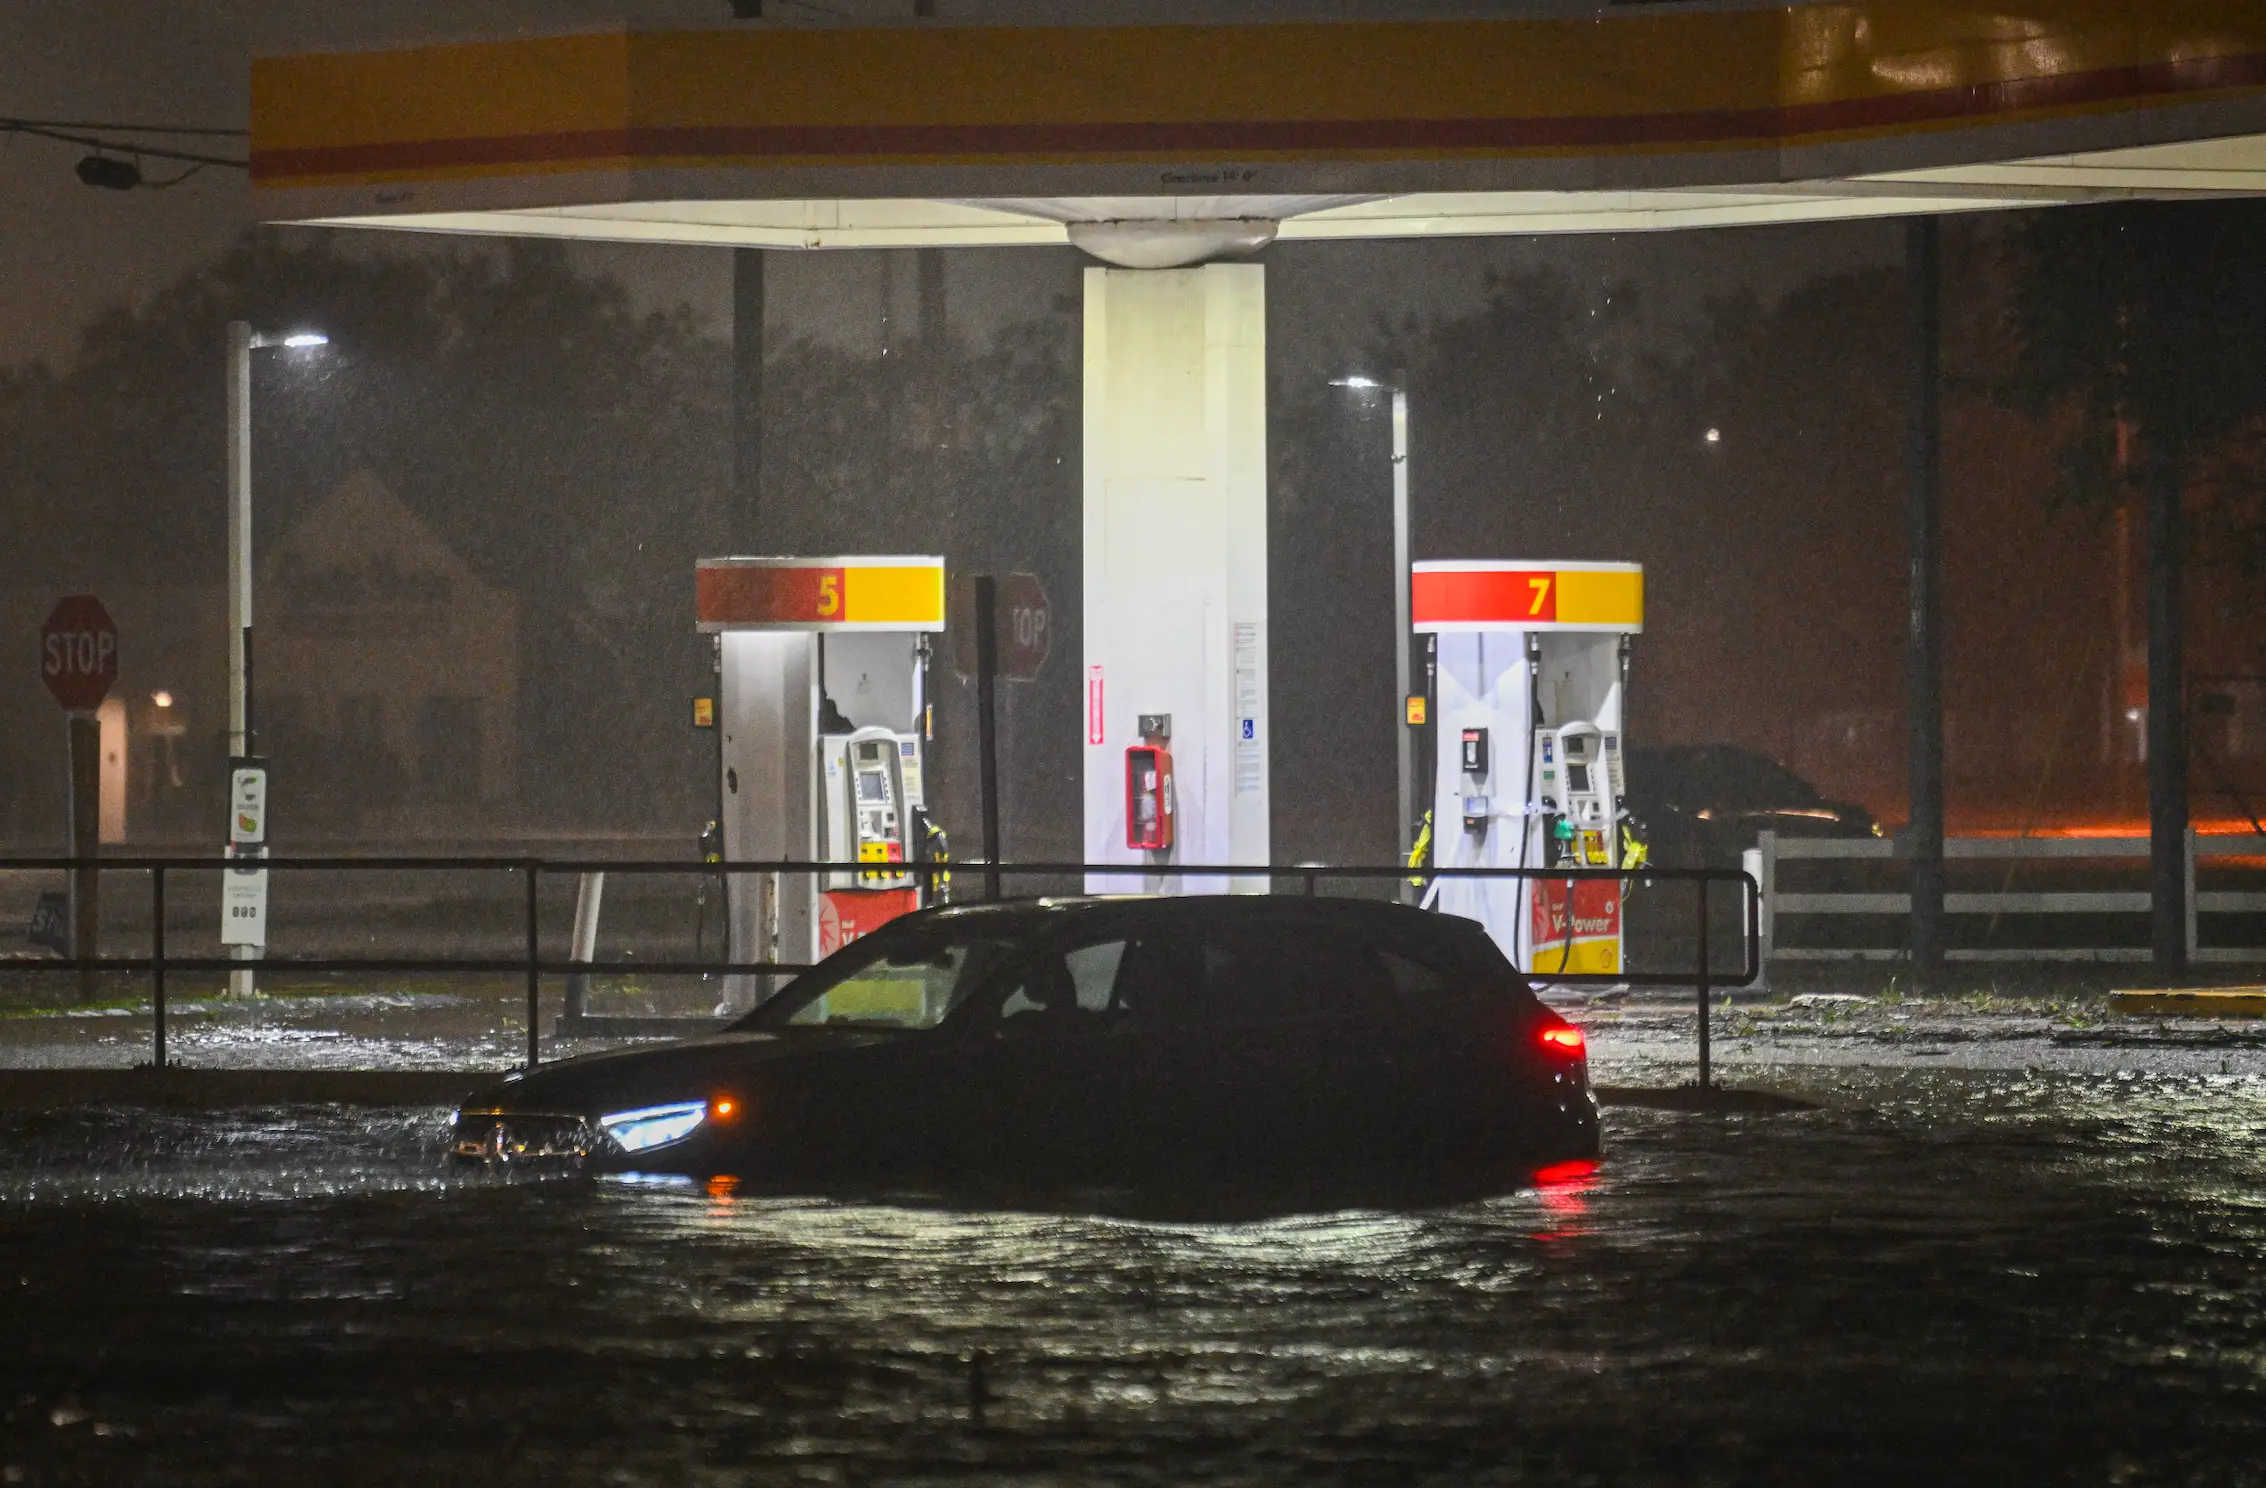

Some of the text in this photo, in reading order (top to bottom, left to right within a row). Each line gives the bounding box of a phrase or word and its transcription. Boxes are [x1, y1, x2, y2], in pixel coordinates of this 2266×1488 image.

[816, 575, 839, 617] 5
[1528, 577, 1551, 616] 7
[1012, 607, 1046, 649] TOP
[45, 630, 115, 676] STOP
